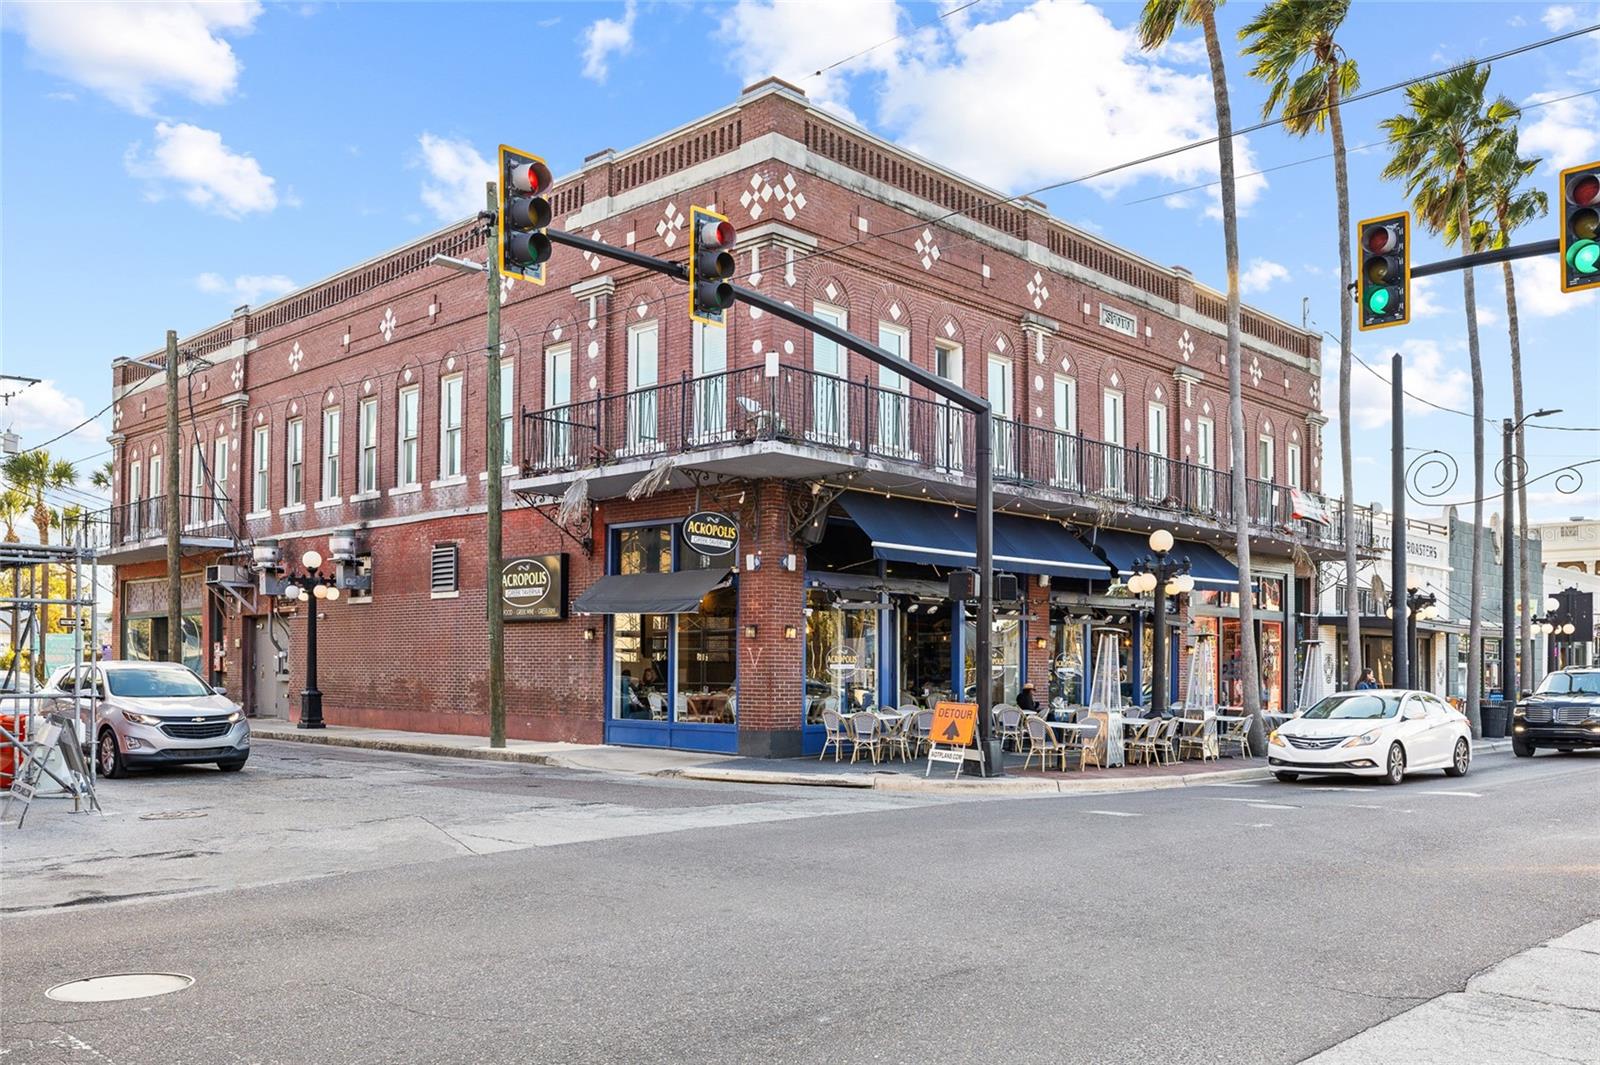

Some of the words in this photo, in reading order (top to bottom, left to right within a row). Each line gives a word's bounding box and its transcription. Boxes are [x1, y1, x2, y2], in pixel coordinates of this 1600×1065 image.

[687, 520, 736, 540] ACROPOLIS
[1406, 541, 1437, 559] ROASTERS
[502, 571, 547, 587] ACROPOLIS
[938, 707, 973, 720] DETOUR
